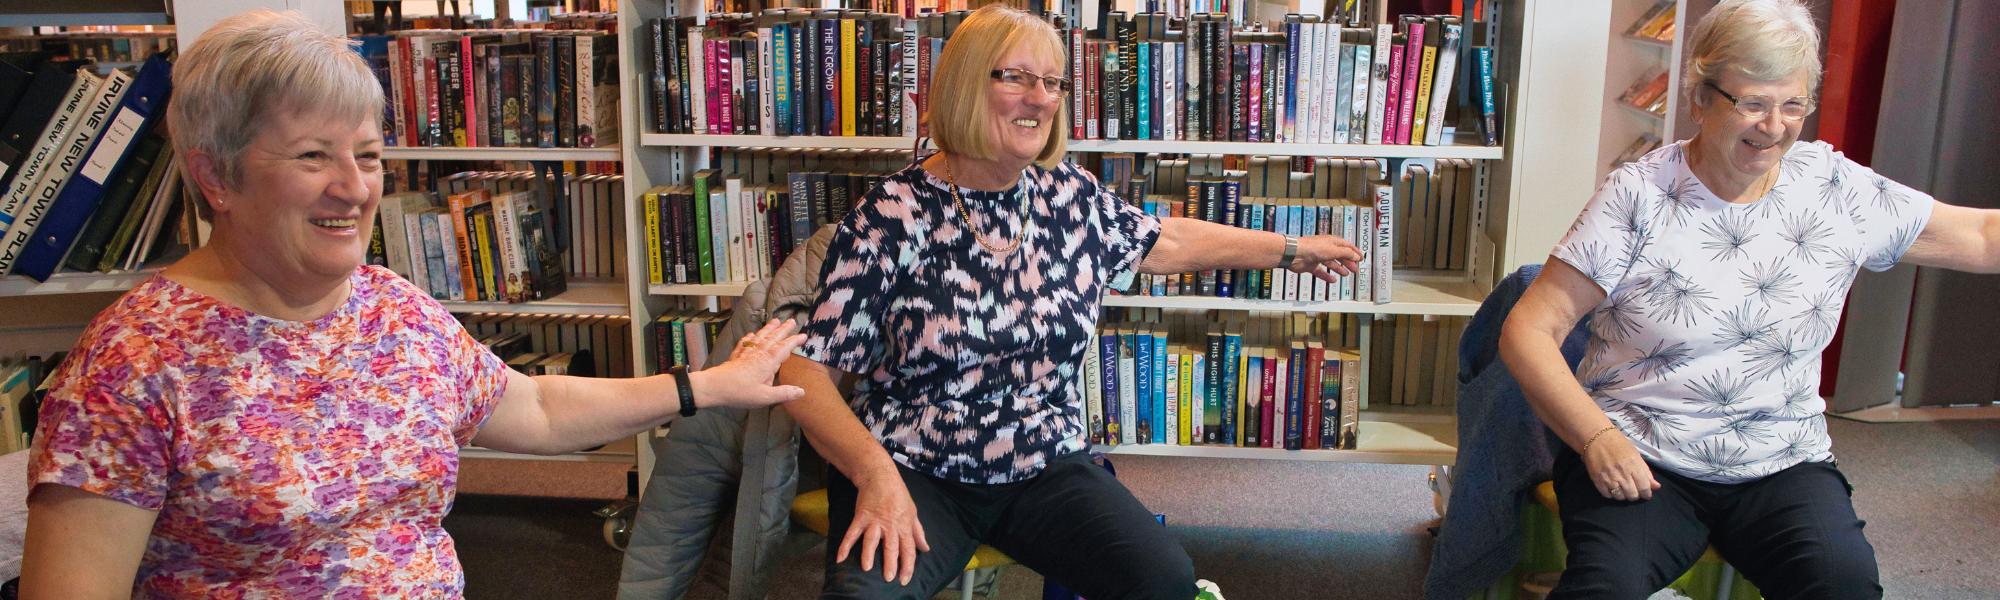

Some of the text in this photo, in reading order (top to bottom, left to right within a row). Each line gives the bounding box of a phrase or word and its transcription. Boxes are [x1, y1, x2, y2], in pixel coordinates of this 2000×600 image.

[1378, 28, 1386, 62] WILLIAMS
[1410, 45, 1418, 65] HUNGRY
[1412, 33, 1420, 43] THE
[450, 52, 459, 89] TRIGGER
[709, 64, 714, 73] MY
[775, 31, 786, 101] TRUST HER
[825, 27, 834, 90] THE IN CROWD
[859, 47, 870, 100] Reputation
[904, 29, 915, 90] TRUST IN ME
[1119, 26, 1129, 92] AT THE END
[1129, 32, 1137, 85] WE BEGIN
[1421, 63, 1431, 97] WILLIAMS
[581, 97, 594, 125] Evil
[1233, 99, 1241, 129] WILKINS
[1402, 100, 1411, 125] WILLIAMS
[4, 115, 69, 213] NEW TOWN PLAN
[25, 76, 125, 227] IRVINE NEW TOWN
[452, 200, 460, 212] PAUL
[792, 181, 808, 222] MINETTE WALTERS
[831, 187, 840, 223] WALTERS
[1189, 203, 1199, 213] ON
[1227, 203, 1236, 211] OF
[1380, 199, 1390, 225] QUIET
[386, 208, 394, 239] TAYLOR
[501, 210, 510, 235] WARTIME
[507, 254, 515, 269] CLUB
[1380, 227, 1389, 247] MAN
[458, 237, 469, 268] BAD ANGEL
[657, 326, 665, 351] RUTH
[673, 325, 681, 351] ZERO
[1088, 355, 1096, 389] WOOD
[1105, 342, 1115, 389] Val WOOD
[1139, 342, 1148, 389] Val WOOD
